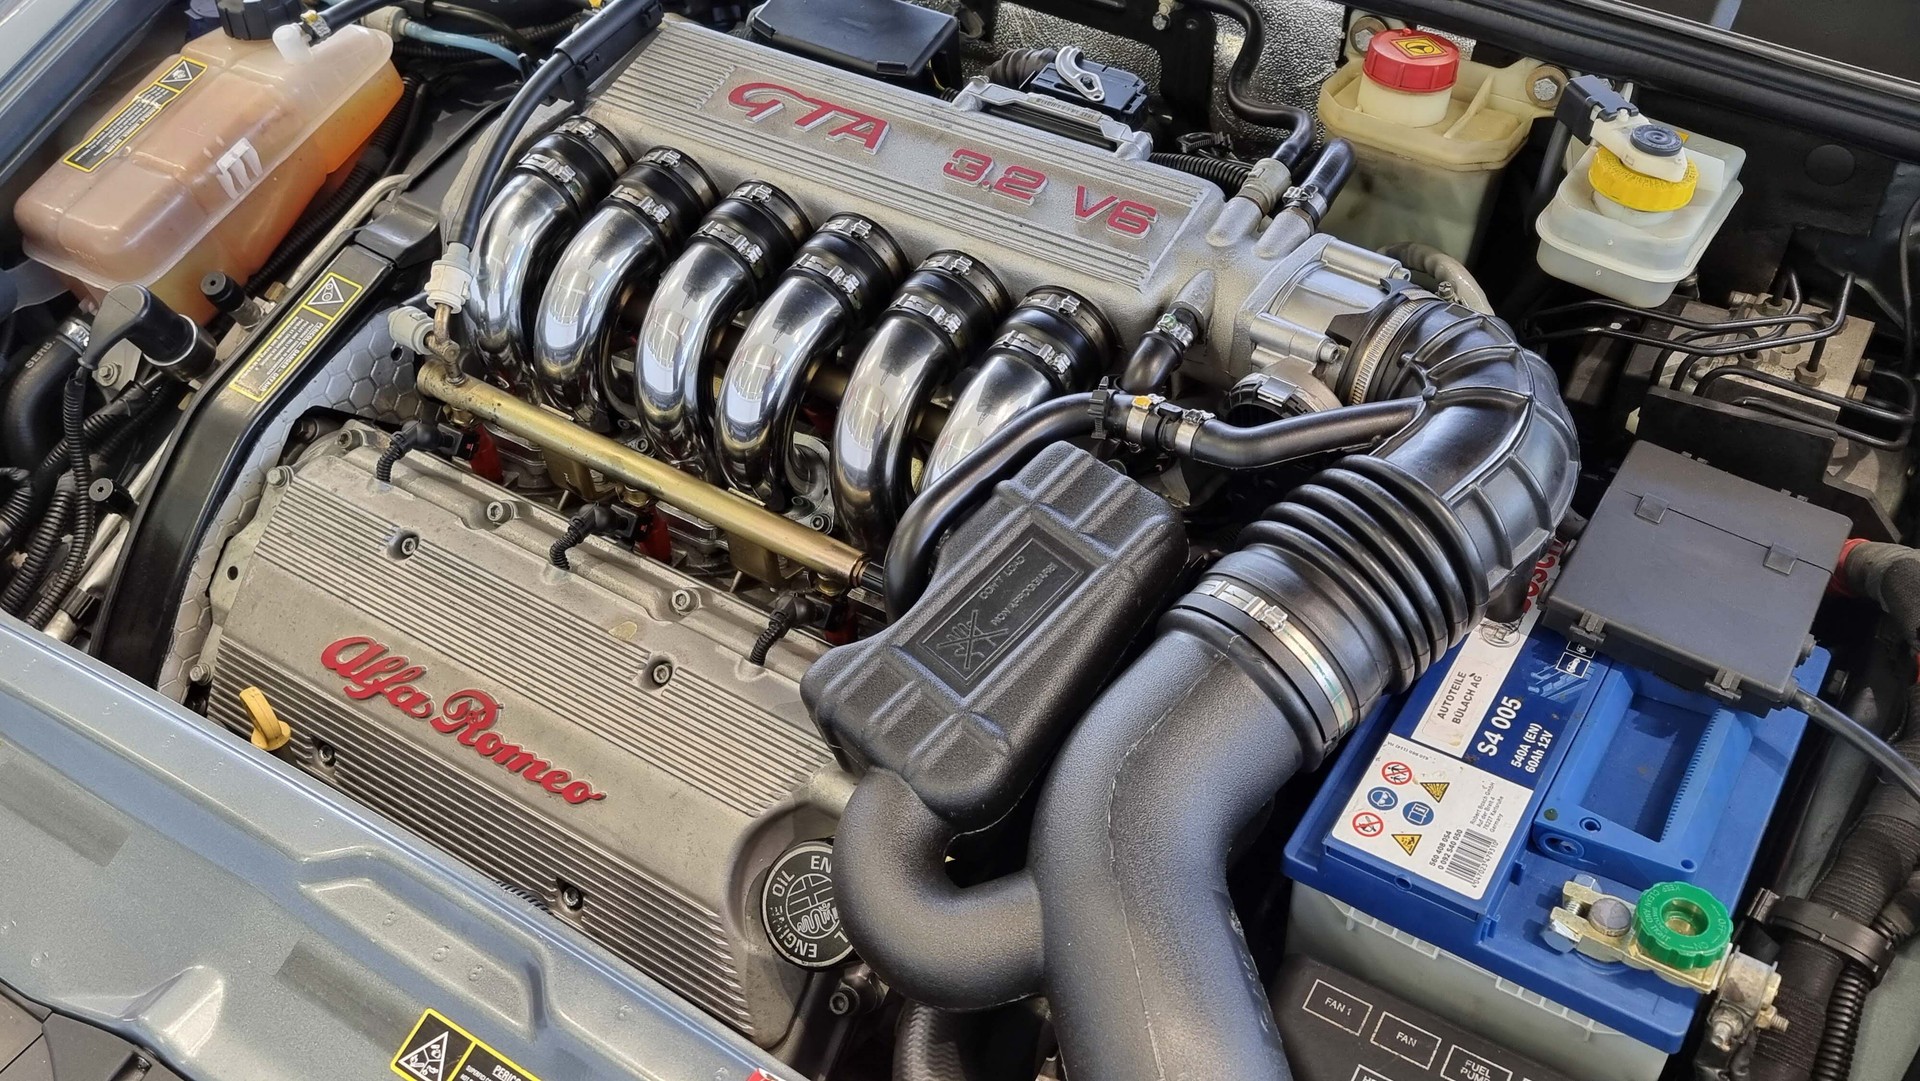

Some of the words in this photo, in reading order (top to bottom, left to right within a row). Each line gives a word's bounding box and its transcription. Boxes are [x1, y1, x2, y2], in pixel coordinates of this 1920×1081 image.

[728, 82, 890, 155] GTA
[942, 148, 1048, 206] 3.2
[1073, 184, 1158, 240] V6
[1004, 555, 1026, 576] LOAD
[991, 607, 1011, 627] NON
[1473, 675, 1482, 690] AG
[1437, 671, 1467, 719] AUTOTEILE
[320, 635, 435, 719] Alfa
[429, 688, 607, 805] Romeo
[1477, 730, 1504, 757] S4
[1491, 696, 1522, 730] 005
[1511, 744, 1531, 767] 540A
[1523, 722, 1542, 743] (EN)
[1525, 749, 1544, 773] 60Ah
[1537, 730, 1553, 749] 12V
[1429, 853, 1439, 866] 560
[1441, 830, 1451, 842] 054
[1440, 852, 1450, 864] 092
[772, 870, 795, 897] OIL
[1718, 918, 1727, 934] OFF
[1693, 941, 1709, 950] ON
[1324, 997, 1346, 1014] FAN
[1396, 1031, 1418, 1048] FAN
[1464, 1059, 1491, 1078] FUEL
